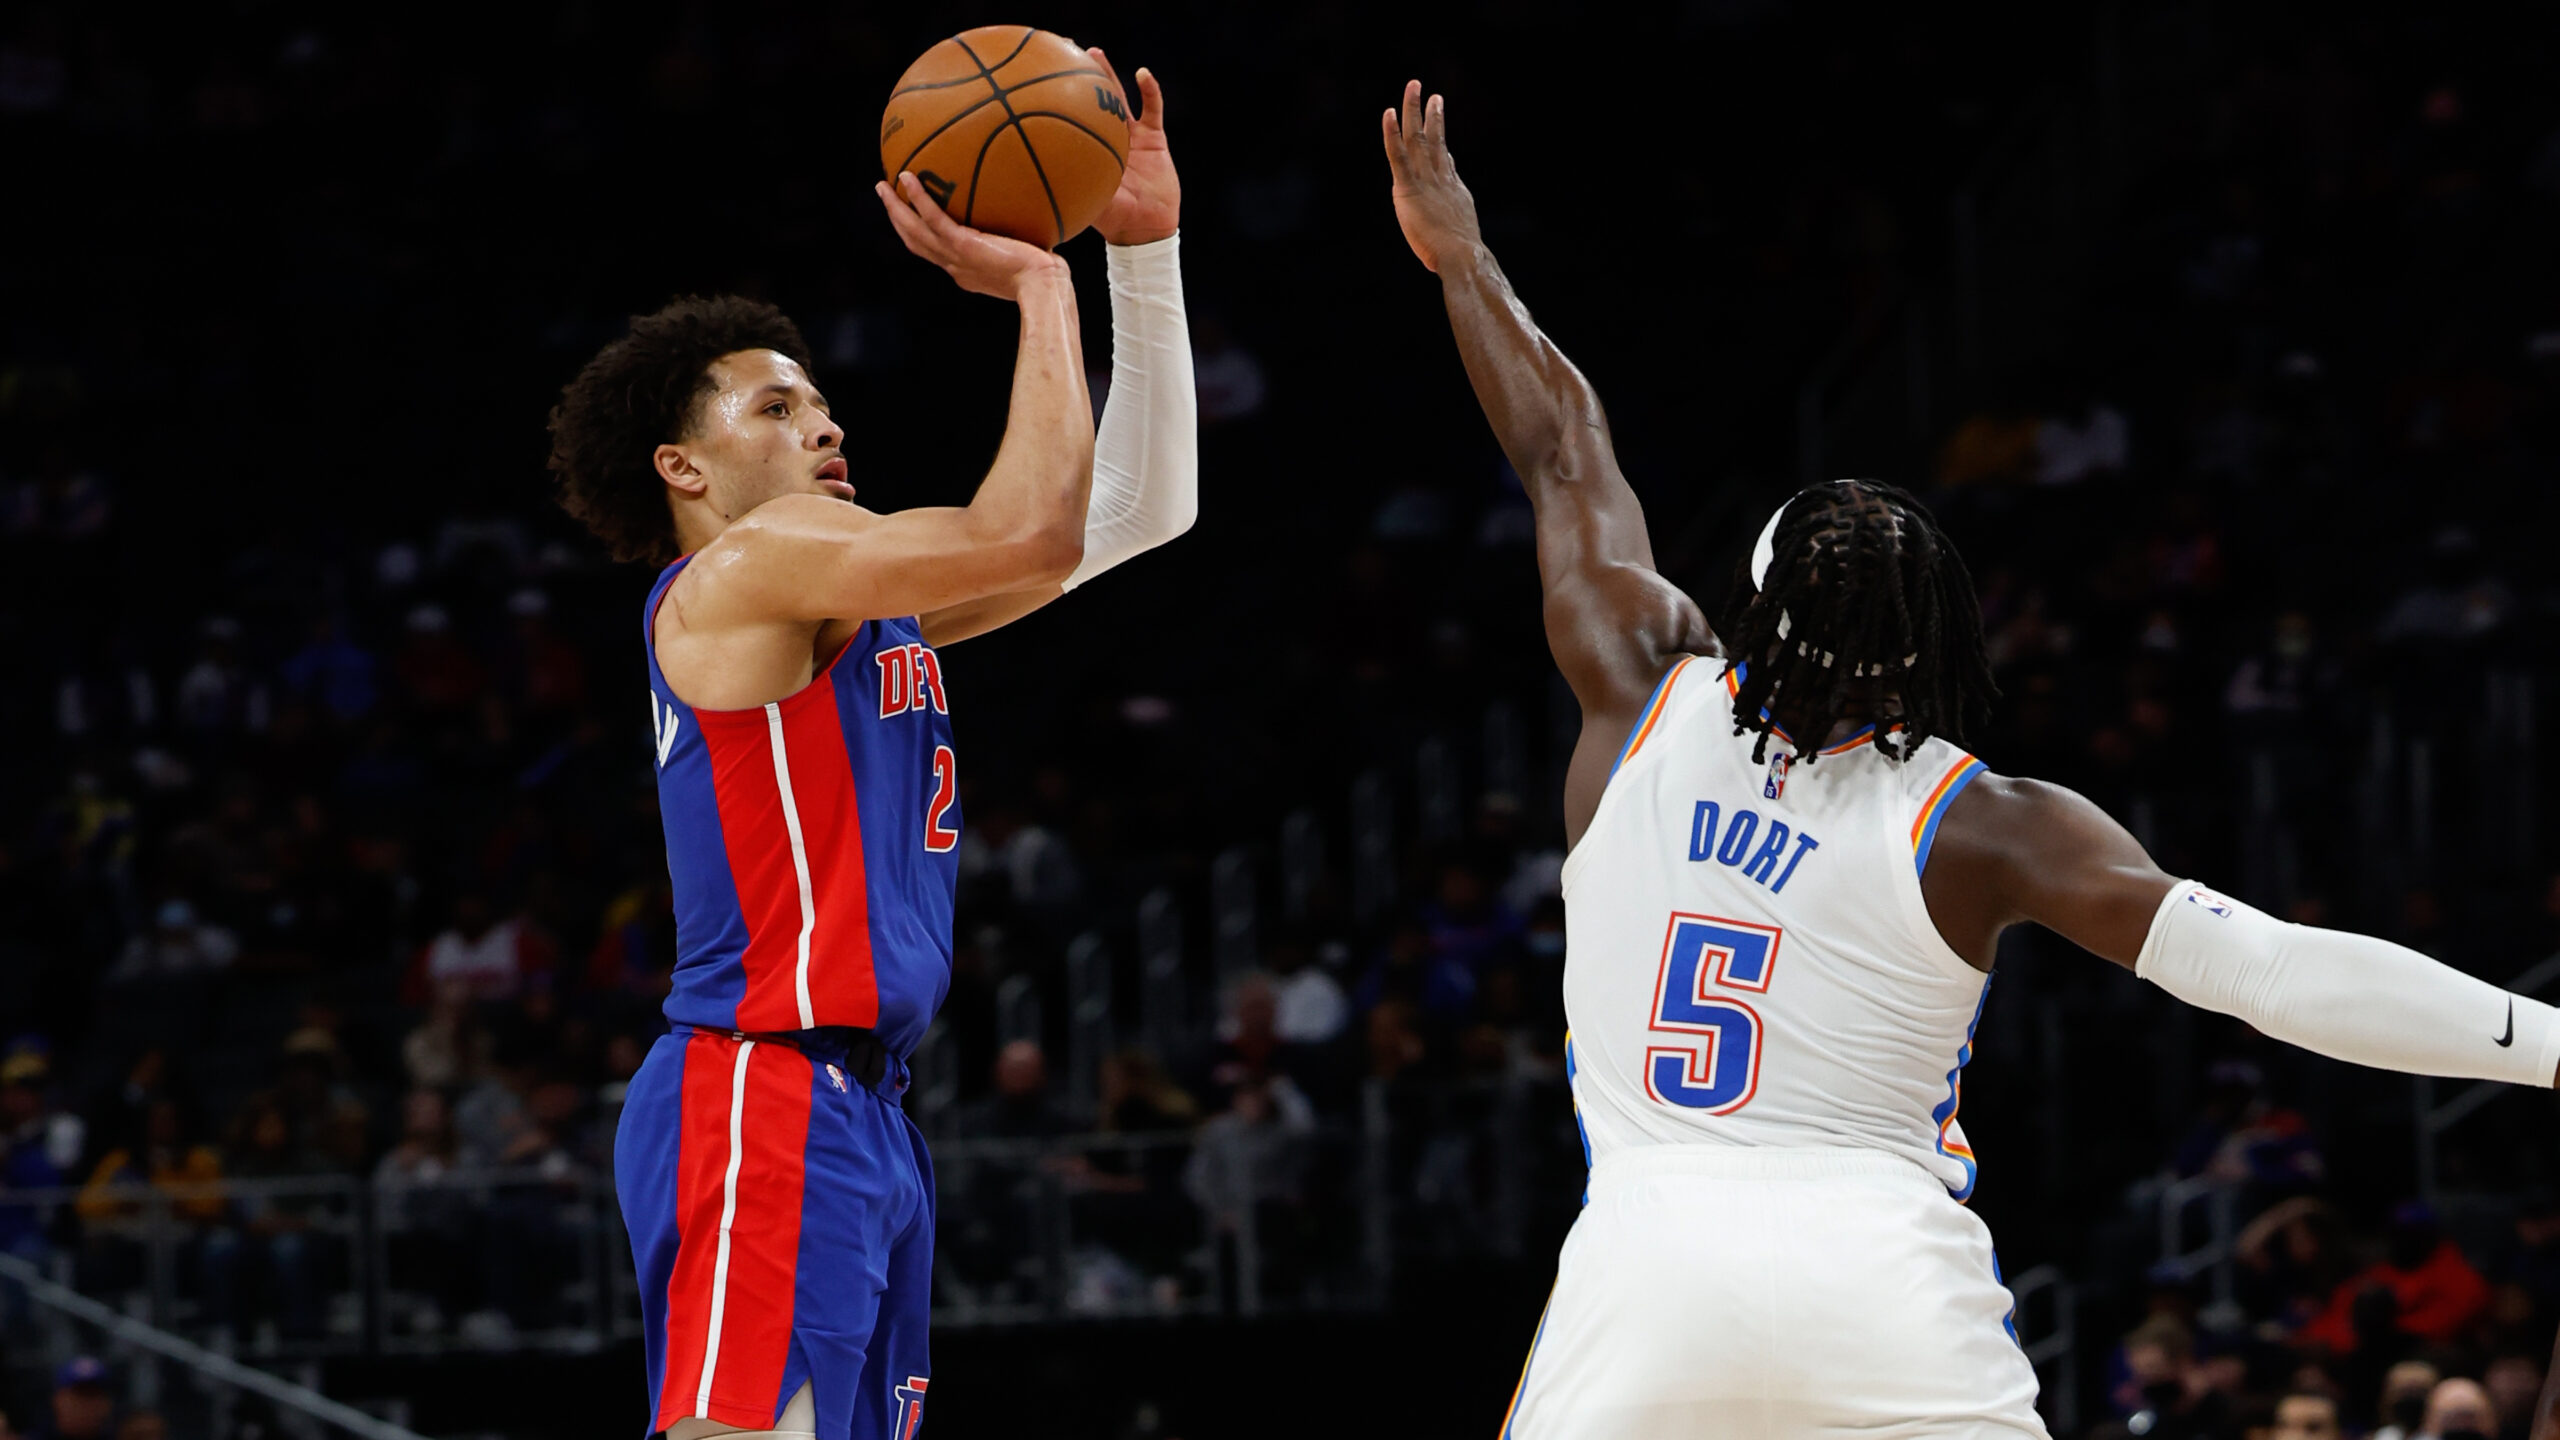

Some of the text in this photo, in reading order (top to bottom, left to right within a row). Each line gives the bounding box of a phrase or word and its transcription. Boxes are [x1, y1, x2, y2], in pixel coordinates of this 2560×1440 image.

[925, 746, 958, 853] 2
[1688, 800, 1819, 894] DORT
[1643, 911, 1782, 1116] 5
